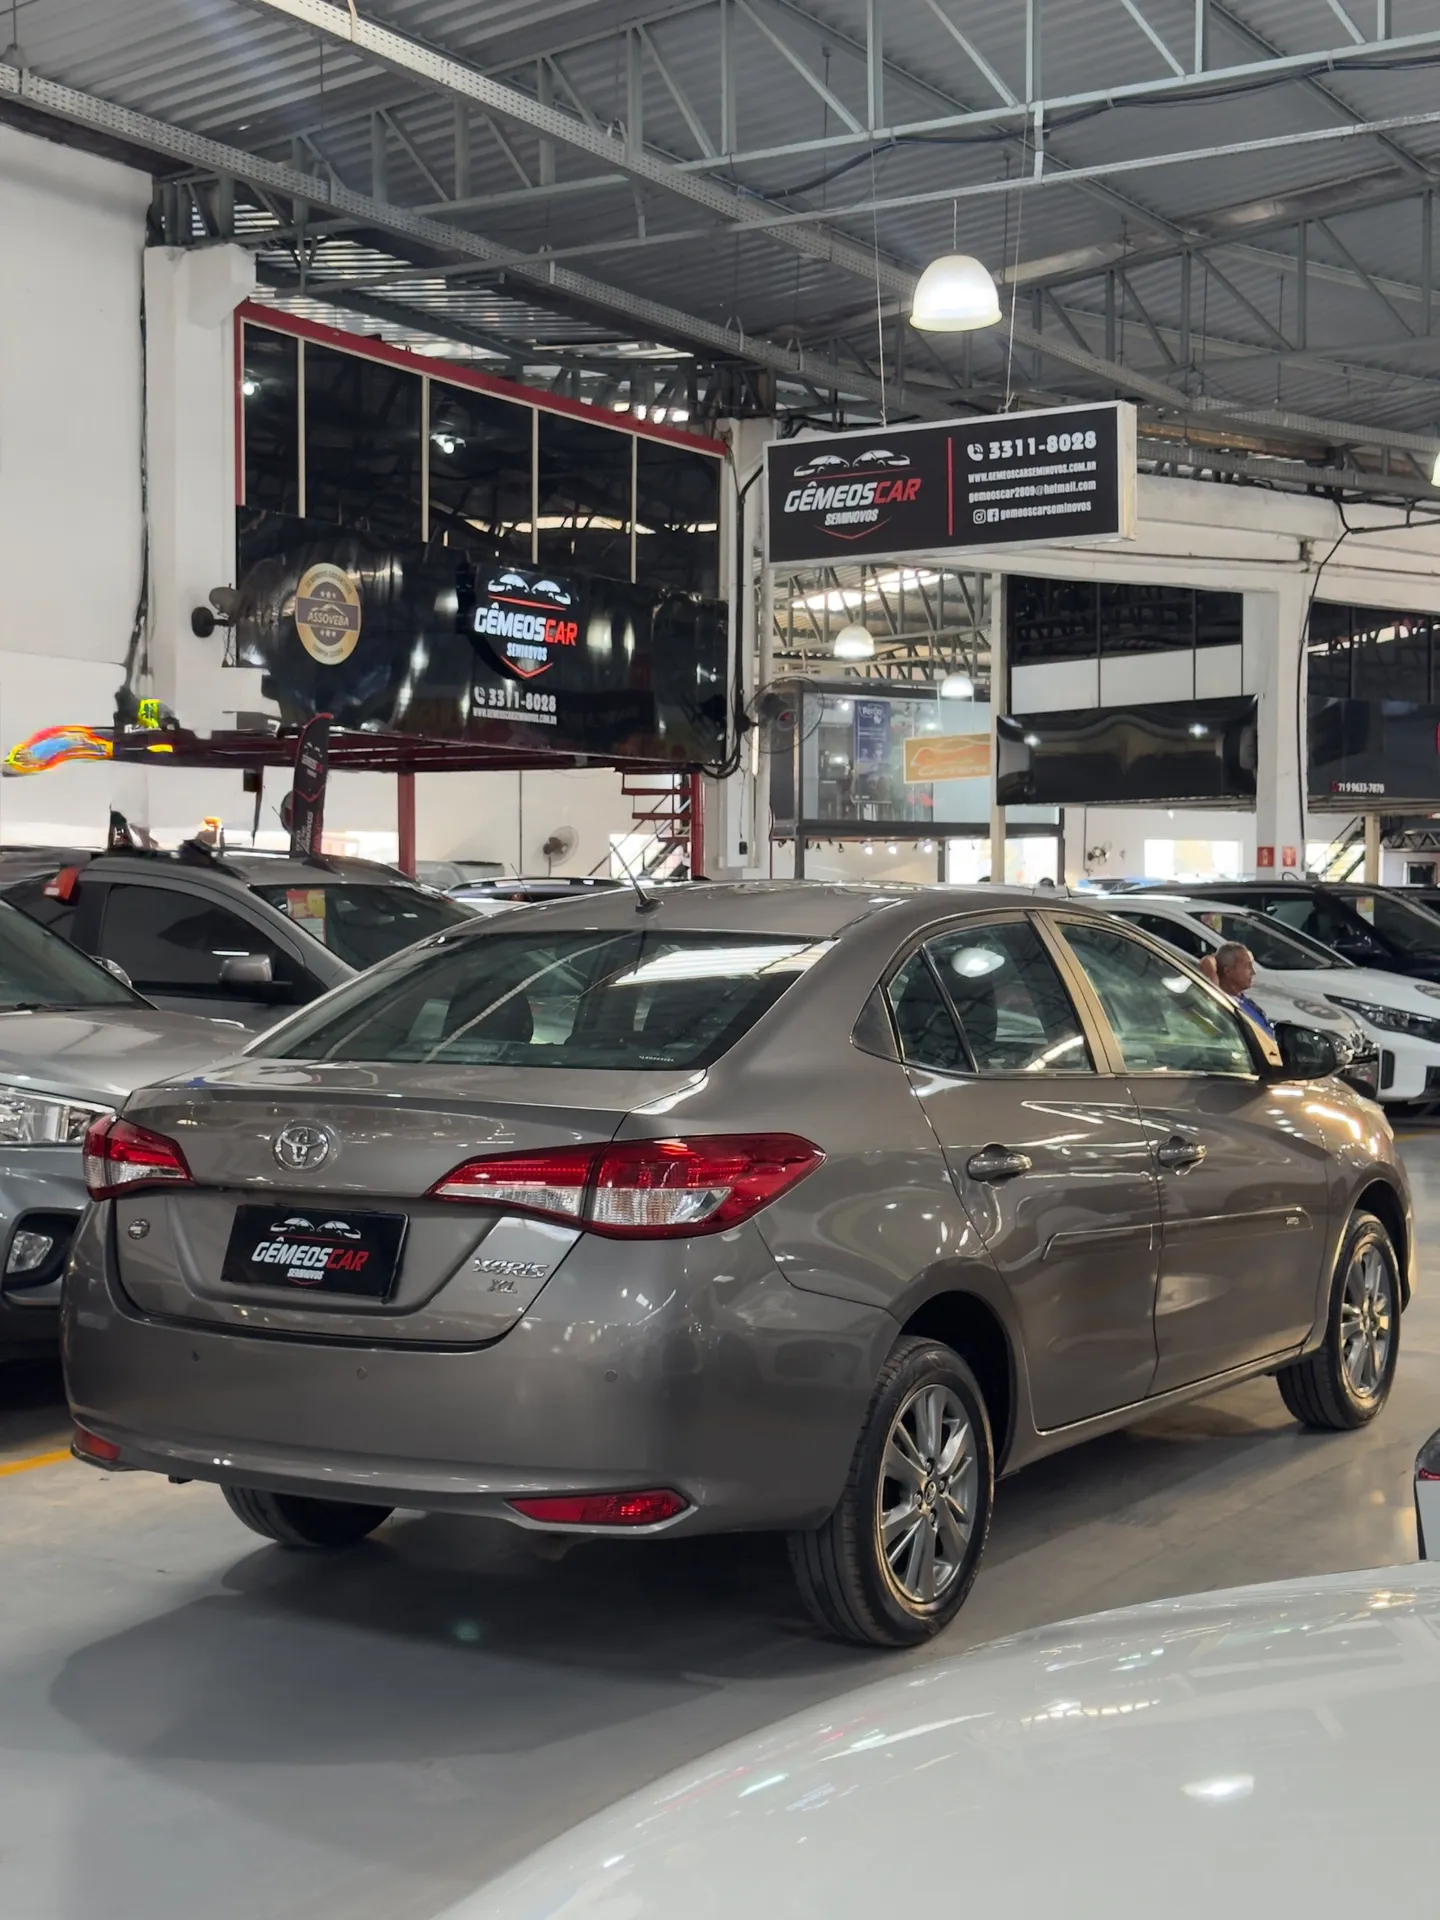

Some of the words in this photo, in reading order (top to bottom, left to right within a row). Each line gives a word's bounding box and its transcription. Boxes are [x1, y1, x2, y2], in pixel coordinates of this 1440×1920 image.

[989, 430, 1097, 460] 3311-8028
[824, 508, 879, 526] SEMINOVOS
[488, 688, 557, 713] 3311-8028
